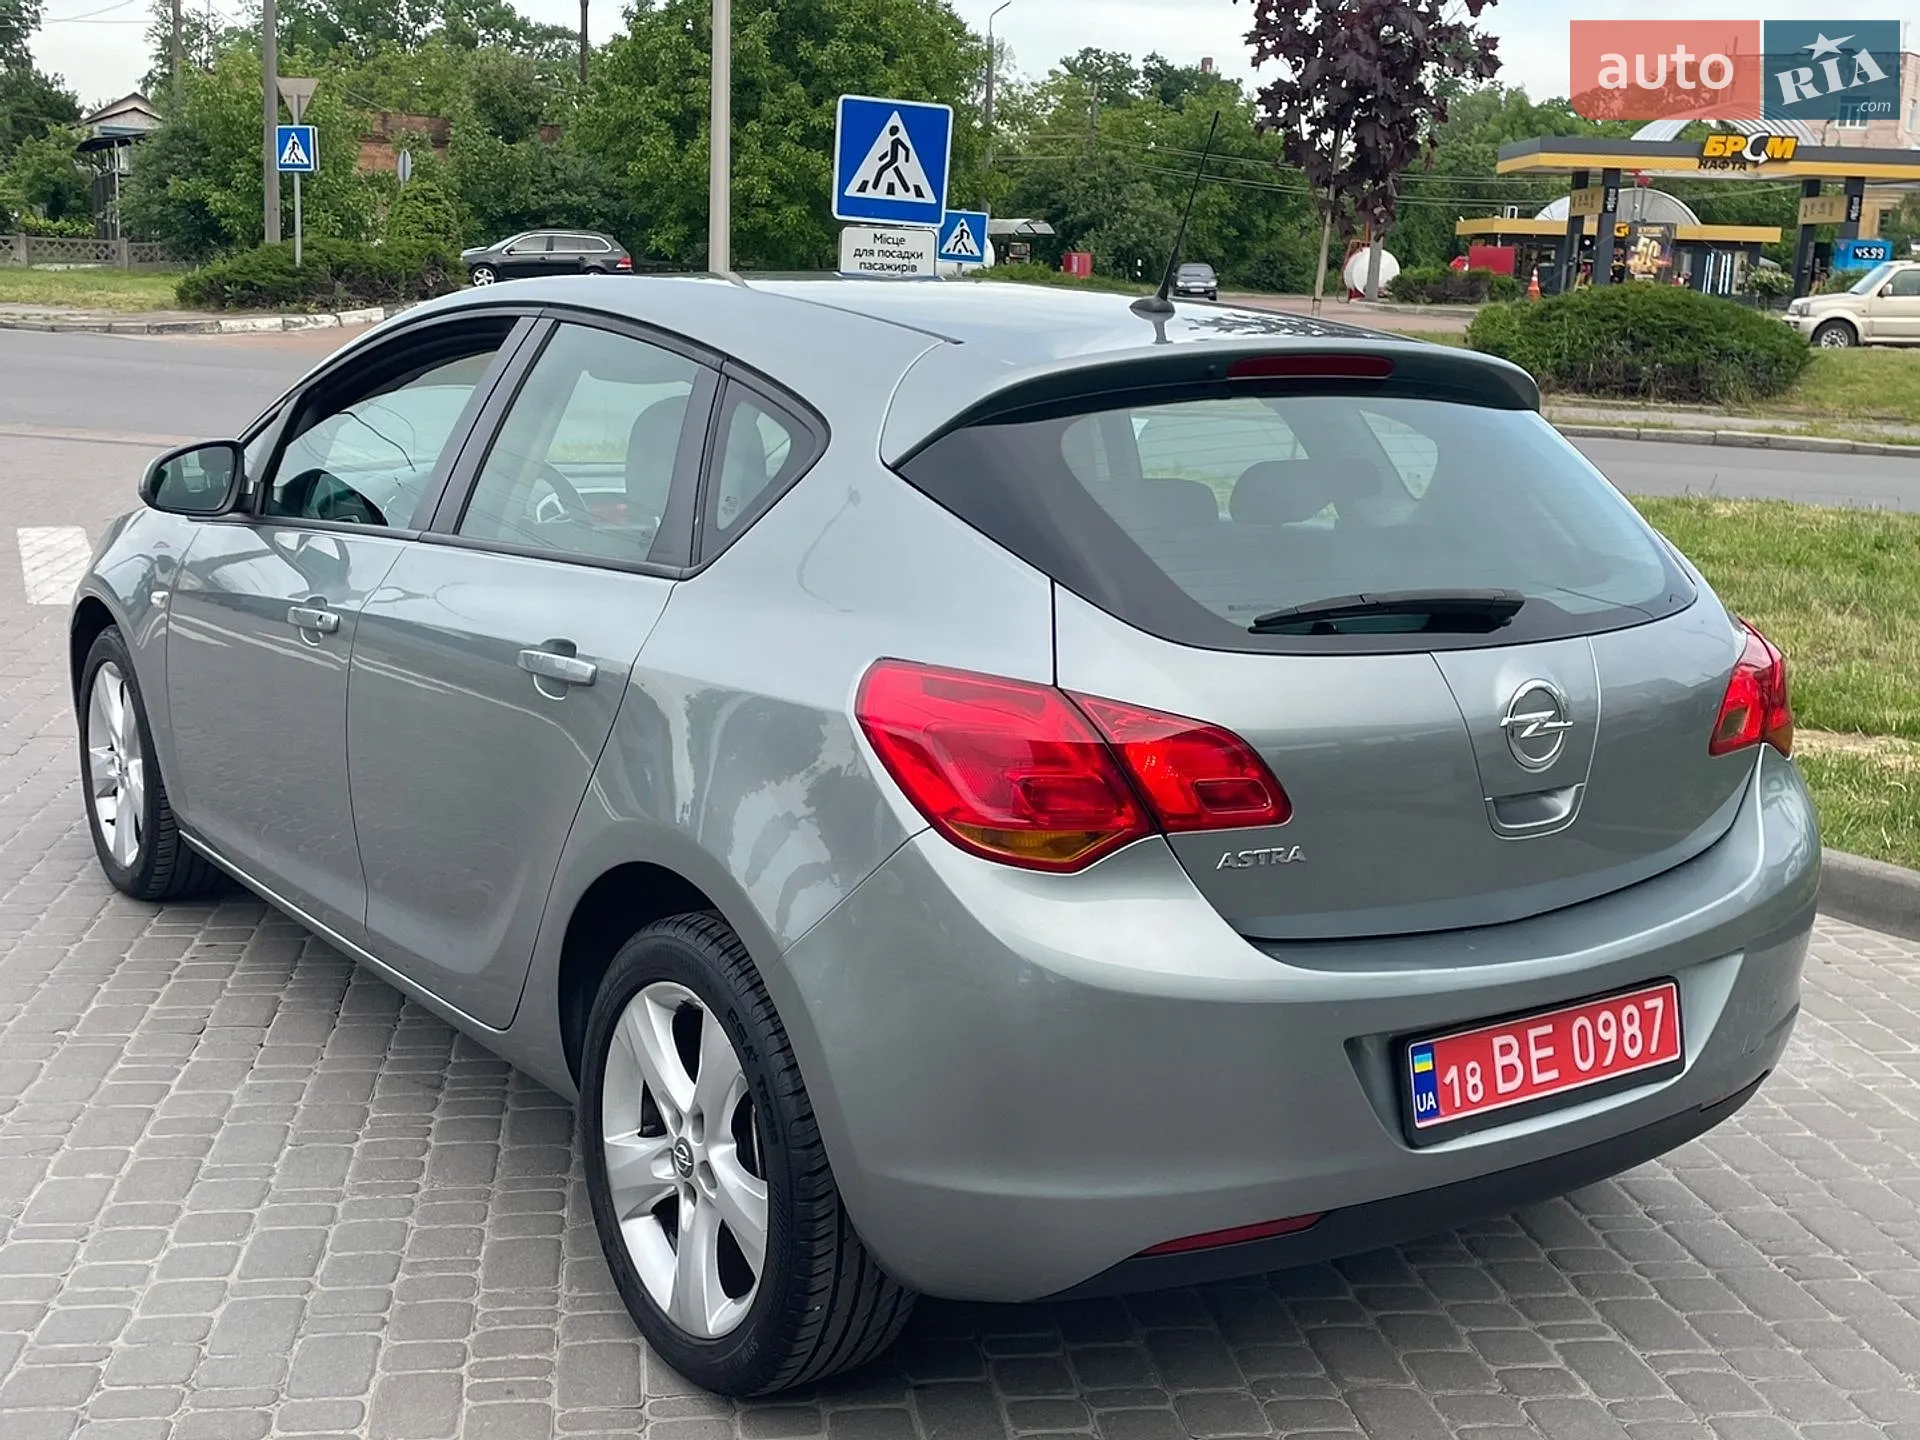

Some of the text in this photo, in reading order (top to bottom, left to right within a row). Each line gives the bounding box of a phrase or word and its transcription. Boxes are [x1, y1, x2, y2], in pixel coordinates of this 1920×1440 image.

[1703, 131, 1798, 164] БРСМ
[873, 233, 906, 246] Місце
[853, 248, 923, 260] для посадки
[859, 261, 918, 274] пасажирів
[1215, 845, 1307, 870] ASTRA
[1443, 997, 1664, 1109] 18 BE 0987
[1416, 1091, 1437, 1113] UA
